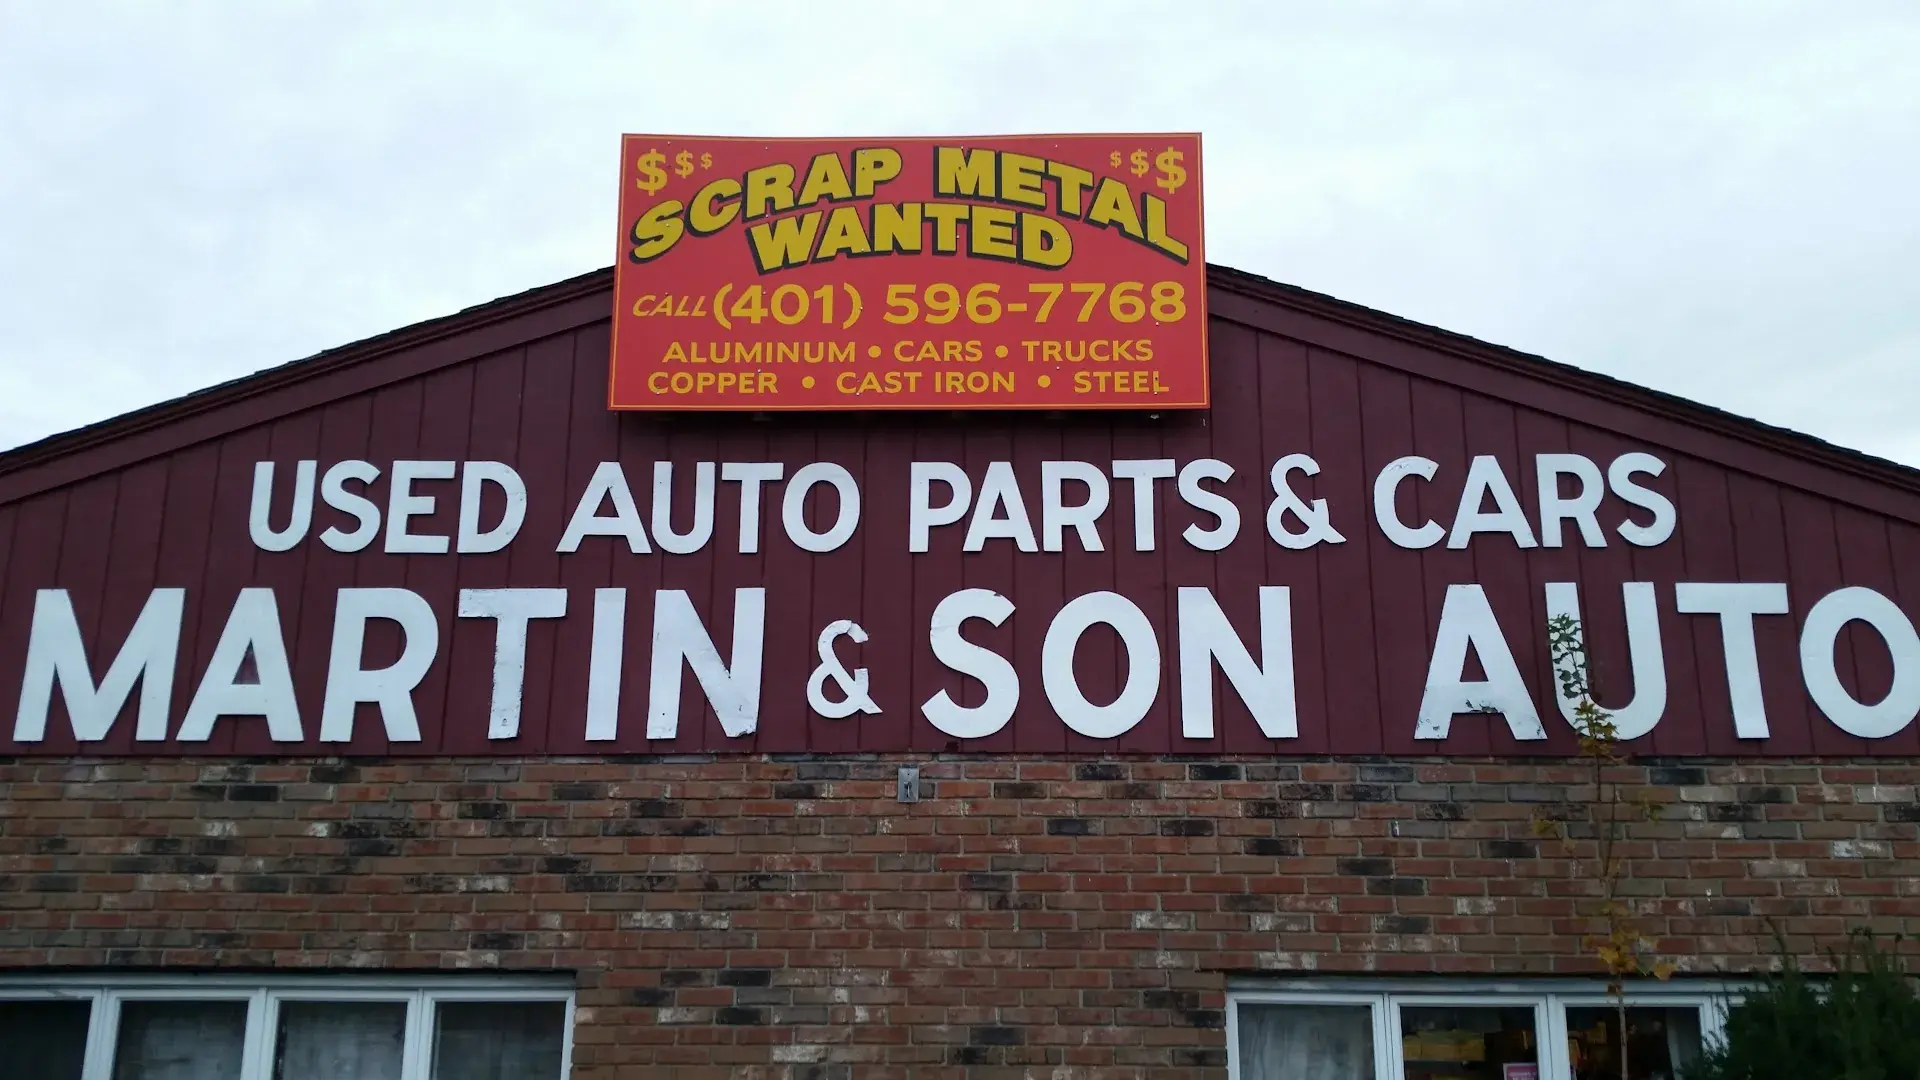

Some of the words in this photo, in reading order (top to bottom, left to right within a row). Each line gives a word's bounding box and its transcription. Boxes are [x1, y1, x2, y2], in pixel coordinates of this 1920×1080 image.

[630, 147, 903, 262] SCRAP
[935, 146, 1189, 263] METAL
[747, 202, 1073, 273] WANTED
[632, 294, 708, 318] CALL
[712, 283, 863, 330] (401)
[882, 281, 1187, 325] 596-7768
[647, 371, 778, 395] COPPER
[836, 371, 923, 394] CAST
[935, 371, 1016, 394] IRON
[1073, 370, 1171, 394] STEEL
[662, 340, 857, 364] ALUMINUM
[893, 338, 983, 363] CARS
[1022, 338, 1154, 362] TRUCKS
[248, 459, 528, 555] USED
[555, 460, 862, 555] AUTO
[908, 457, 1242, 554] PARTS
[1266, 452, 1348, 551] &
[1373, 451, 1677, 550] CARS
[12, 586, 767, 744] MARTIN
[805, 618, 884, 720] &
[920, 586, 1299, 740] SON
[1413, 580, 1920, 741] AUTO
